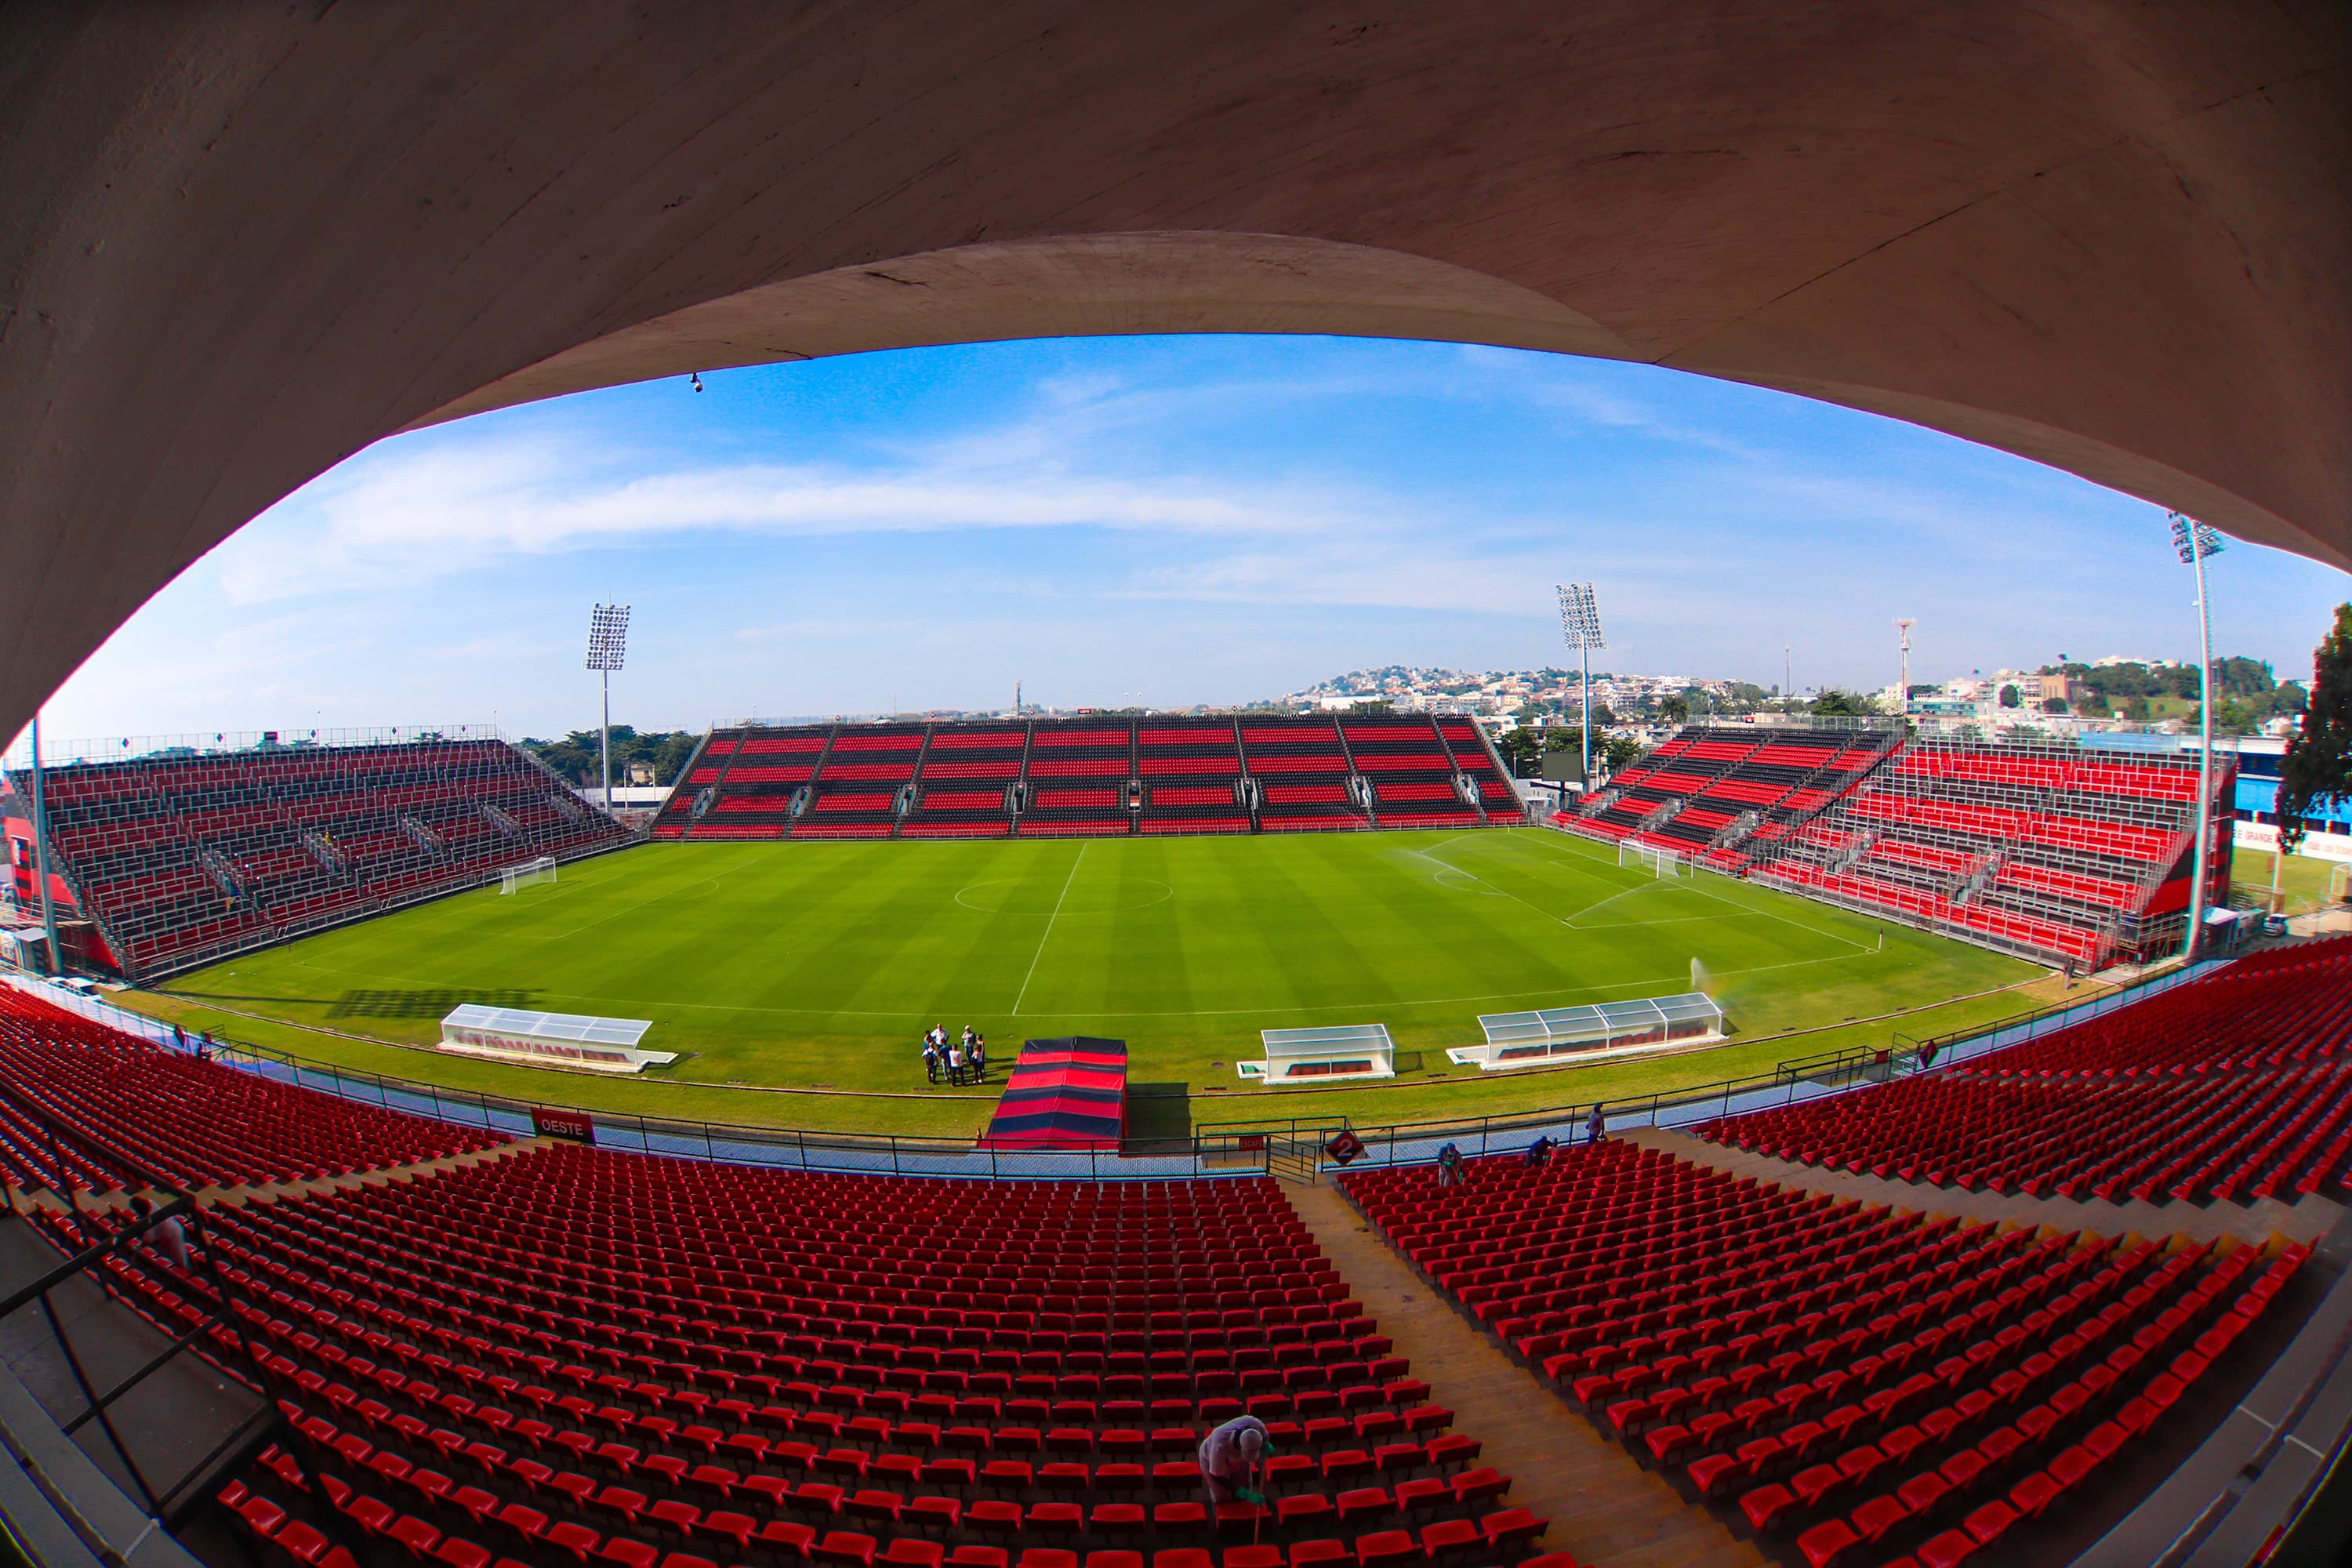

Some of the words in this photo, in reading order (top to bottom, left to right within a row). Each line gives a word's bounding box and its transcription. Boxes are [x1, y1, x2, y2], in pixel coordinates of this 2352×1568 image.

[2245, 831, 2273, 843] GRANDE
[542, 1119, 583, 1135] OESTE
[1240, 1139, 1263, 1149] ESCAPE
[1338, 1139, 1352, 1157] 2
